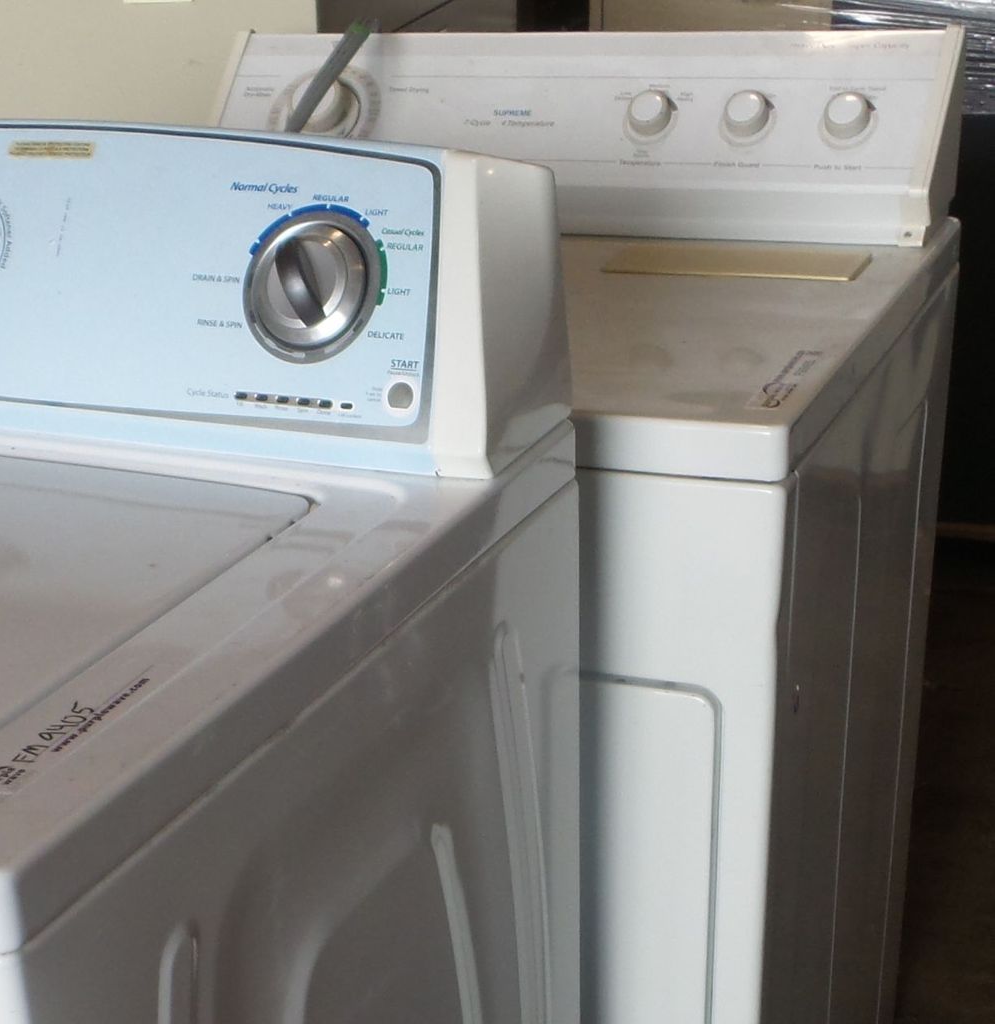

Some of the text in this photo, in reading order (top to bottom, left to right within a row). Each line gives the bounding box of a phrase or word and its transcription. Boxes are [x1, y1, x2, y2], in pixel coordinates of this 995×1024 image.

[493, 108, 532, 117] SUPREME
[229, 181, 299, 195] Normal Cycles
[312, 193, 350, 203] REGULAR
[267, 202, 293, 212] HEAVY
[364, 208, 389, 218] LIGHT
[381, 227, 425, 238] Casual Cycles
[386, 242, 424, 252] REGULAR
[192, 273, 216, 283] DRAIN
[222, 275, 241, 285] SPIN
[387, 287, 411, 297] LIGHT
[197, 318, 219, 328] RINSE
[225, 320, 243, 330] SPIN
[367, 330, 405, 342] DELICATE
[390, 359, 420, 369] START
[186, 387, 230, 399] Cycle Status
